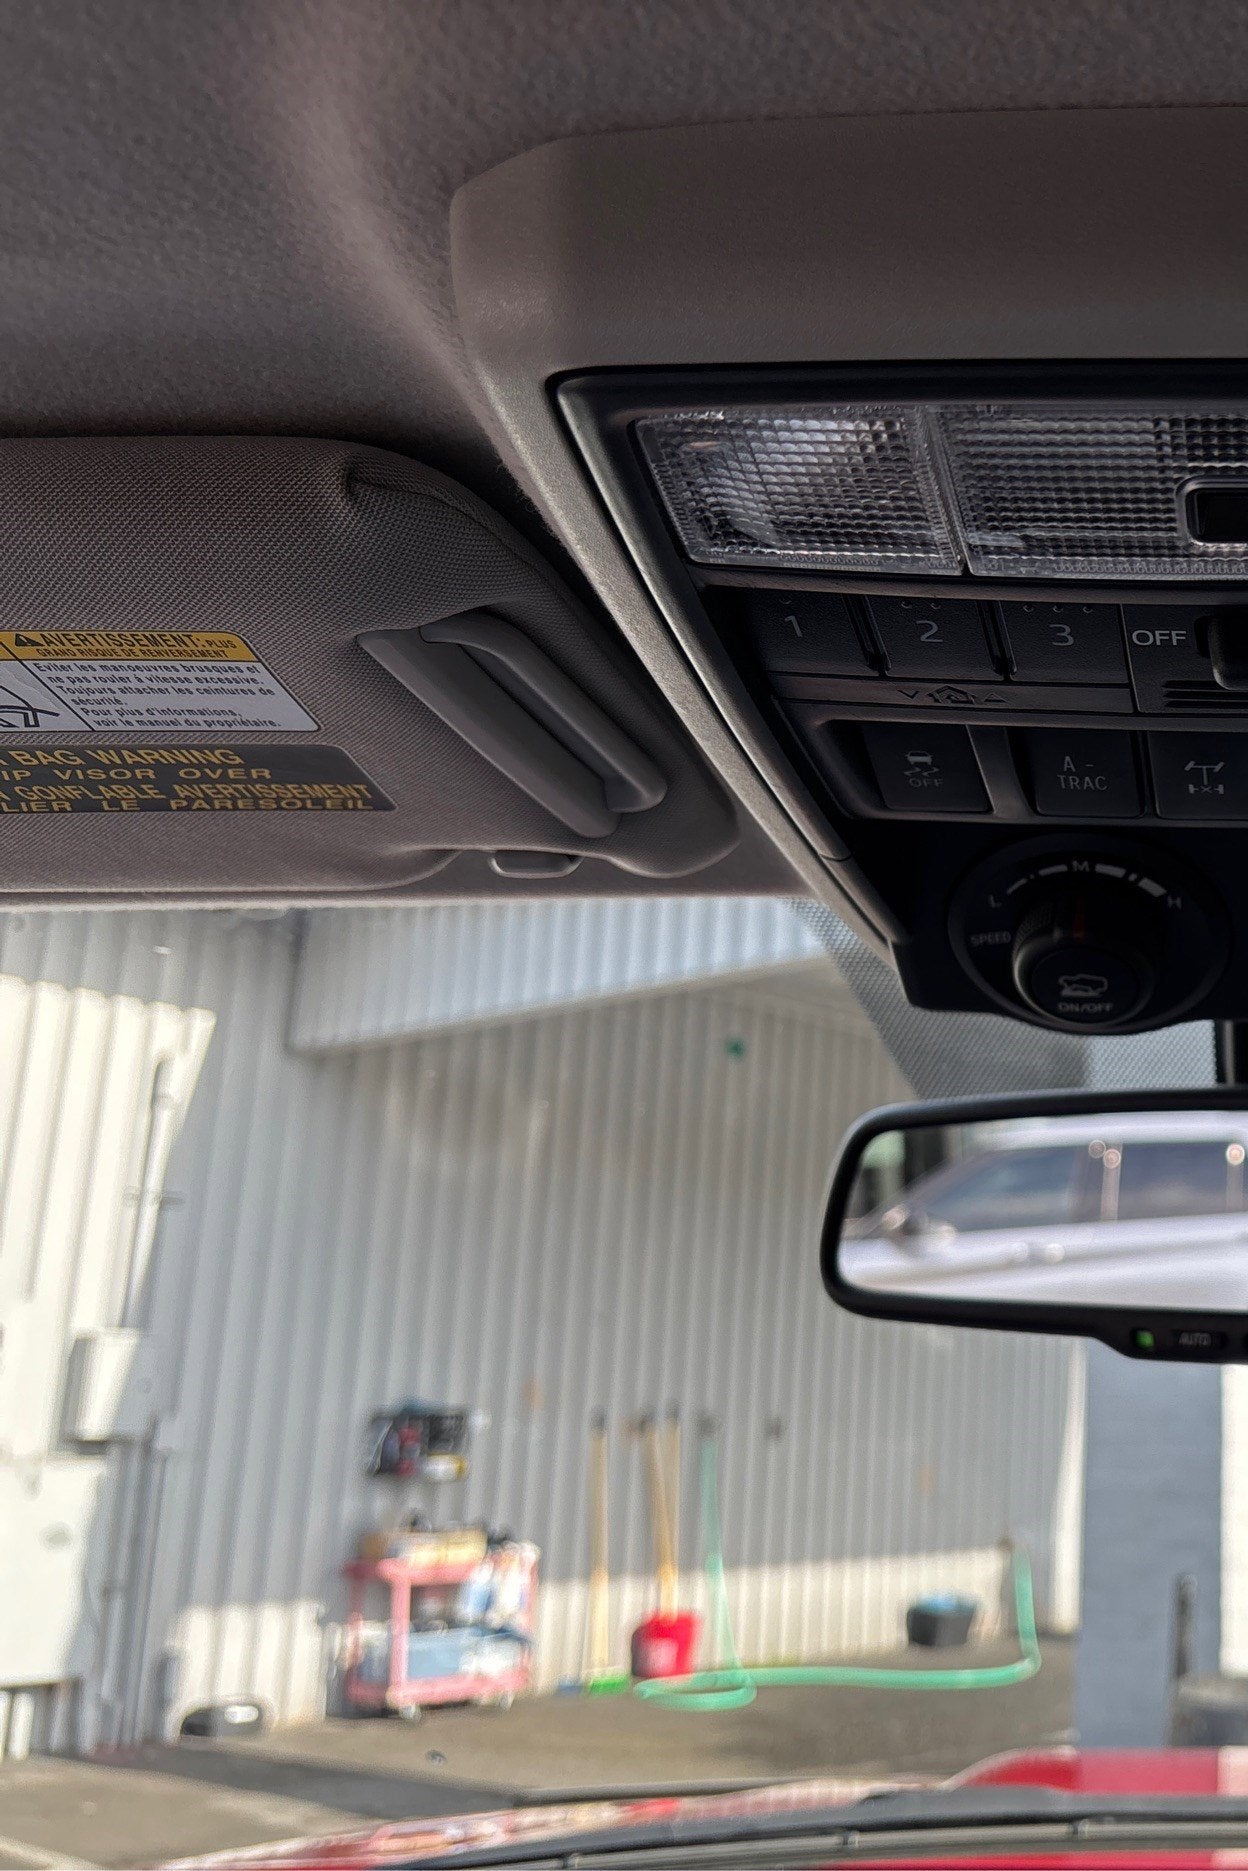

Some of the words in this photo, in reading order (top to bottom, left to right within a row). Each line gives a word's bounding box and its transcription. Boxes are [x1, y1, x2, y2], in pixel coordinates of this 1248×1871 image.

[784, 615, 802, 638] 1
[915, 620, 943, 642] 2
[1049, 623, 1075, 647] 3
[1131, 629, 1187, 646] OFF
[207, 640, 238, 649] PLUS
[35, 648, 77, 657] GRAND
[79, 648, 122, 658] RISQUE
[123, 648, 140, 658] DE
[140, 648, 230, 659] RENVERSEMENT
[74, 662, 98, 673] les
[100, 664, 180, 673] manoeuvres
[180, 663, 244, 675] brusques
[246, 665, 261, 674] et
[47, 675, 65, 684] ne
[66, 675, 92, 686] pas
[95, 674, 134, 684] rouler
[145, 674, 193, 684] vitesse
[194, 675, 264, 685] excessive.
[56, 685, 117, 697] Toujours
[119, 685, 171, 695] attacher
[171, 685, 194, 695] les
[196, 686, 256, 695] ceintures
[258, 686, 275, 696] de
[71, 696, 128, 706] sécurité.
[80, 707, 110, 716] Pour
[115, 707, 143, 718] plus
[93, 718, 119, 727] voir
[119, 717, 135, 727] le
[138, 717, 182, 727] manuel
[185, 718, 201, 727] du
[202, 717, 282, 728] propriétaire.
[8, 749, 87, 766] BAG
[84, 749, 245, 766] WARNING
[53, 768, 157, 780] VISOR
[178, 767, 272, 780] OVER
[907, 777, 944, 788] OFF
[1057, 774, 1108, 791] TRAC
[14, 784, 167, 801] GONFLABLE
[172, 783, 373, 800] AVERTISSEMENT
[101, 800, 141, 812] LE
[169, 799, 374, 811] PARESOLEIL
[1071, 860, 1091, 873] M
[970, 931, 1012, 947] SPEED
[1057, 1002, 1114, 1013] ON/OFF
